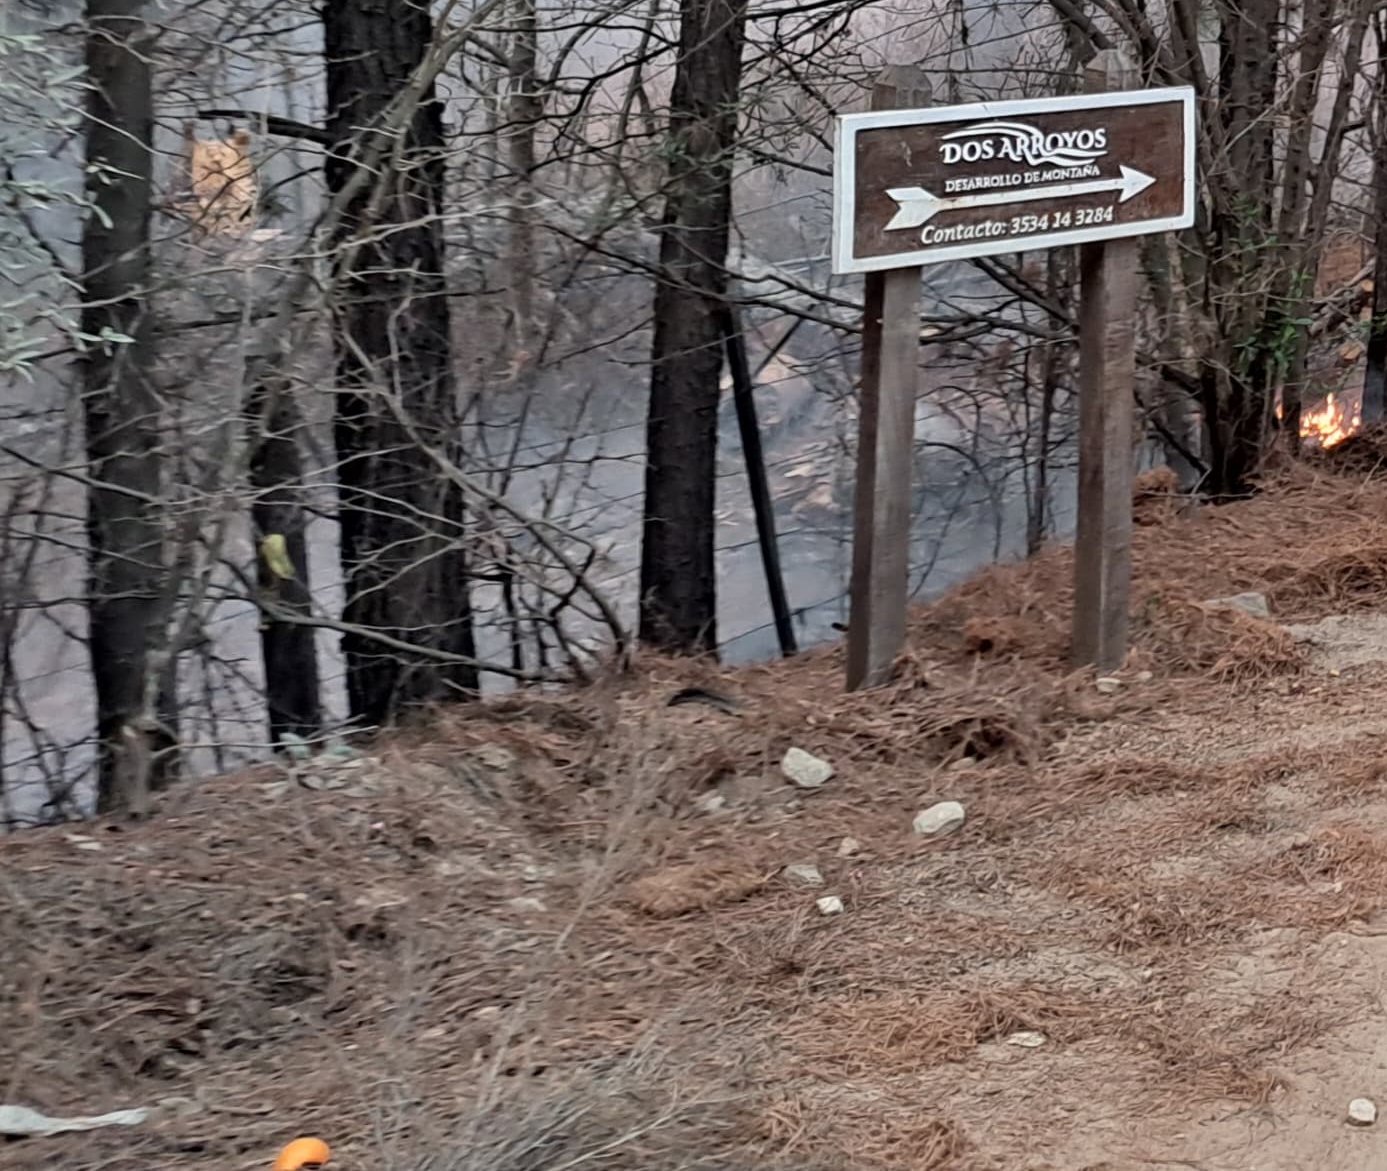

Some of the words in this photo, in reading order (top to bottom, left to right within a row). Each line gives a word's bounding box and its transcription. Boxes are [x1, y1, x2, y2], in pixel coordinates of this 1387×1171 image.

[939, 139, 995, 164] DOS
[997, 128, 1108, 166] ARROYOS
[944, 173, 1022, 193] DESARROLLO
[1023, 170, 1041, 184] DE
[1040, 164, 1100, 182] MONTAÑA
[921, 219, 1007, 245] Contacto:
[1010, 212, 1049, 235] 3534
[1051, 210, 1072, 230] 14
[1074, 204, 1114, 226] 3284
